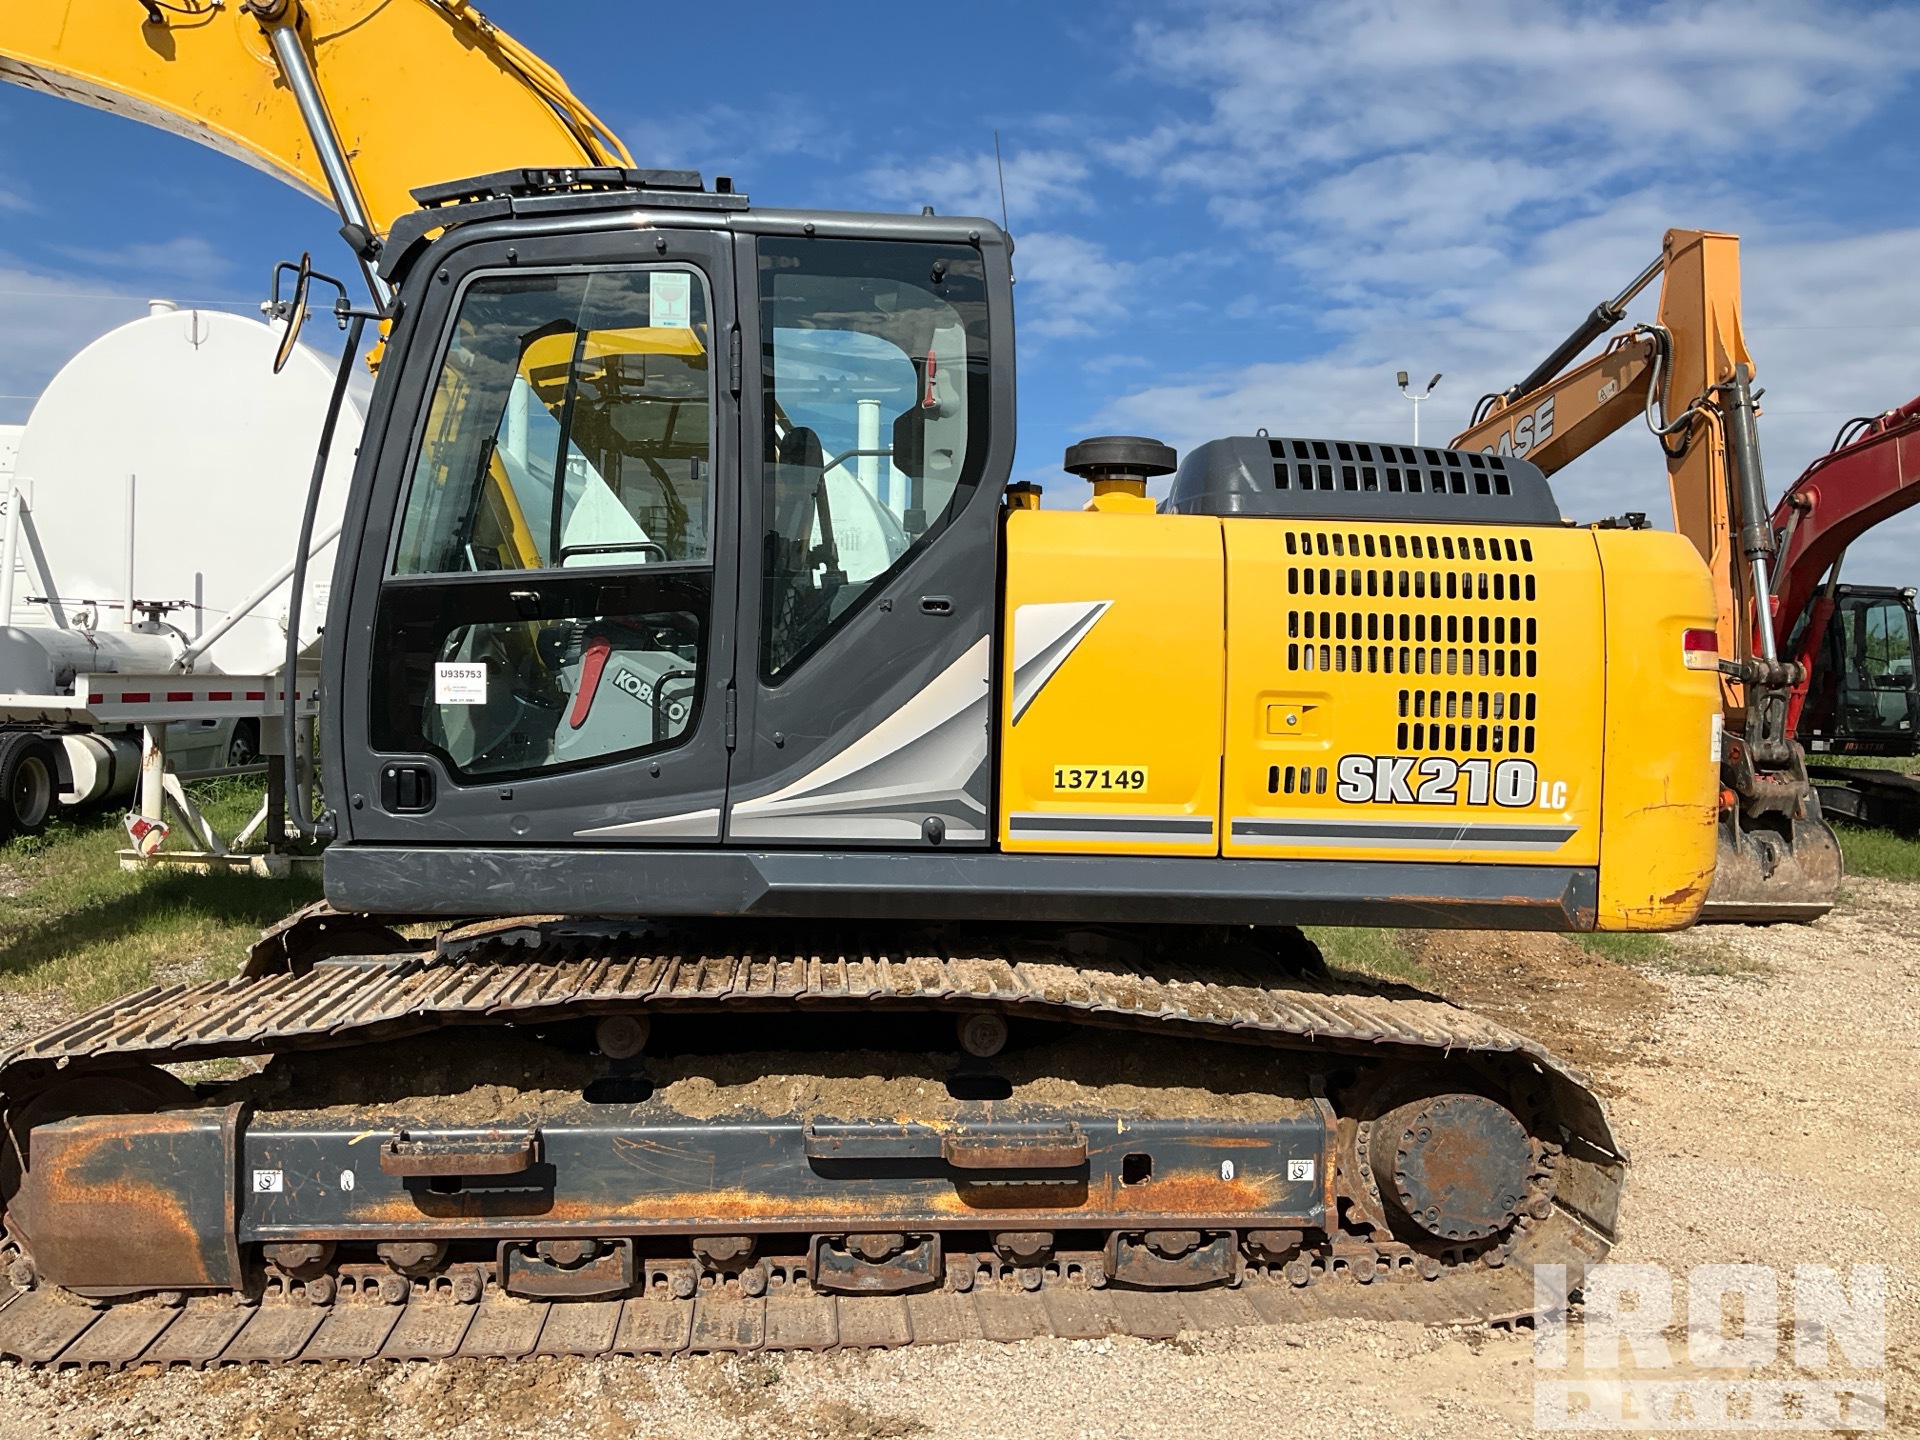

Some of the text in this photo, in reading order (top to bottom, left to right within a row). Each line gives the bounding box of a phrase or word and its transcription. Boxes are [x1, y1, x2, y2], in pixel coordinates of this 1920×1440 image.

[1481, 394, 1555, 459] ASE
[440, 669, 482, 679] U935753
[1054, 769, 1145, 790] 137149
[1337, 754, 1567, 810] SK210 LC
